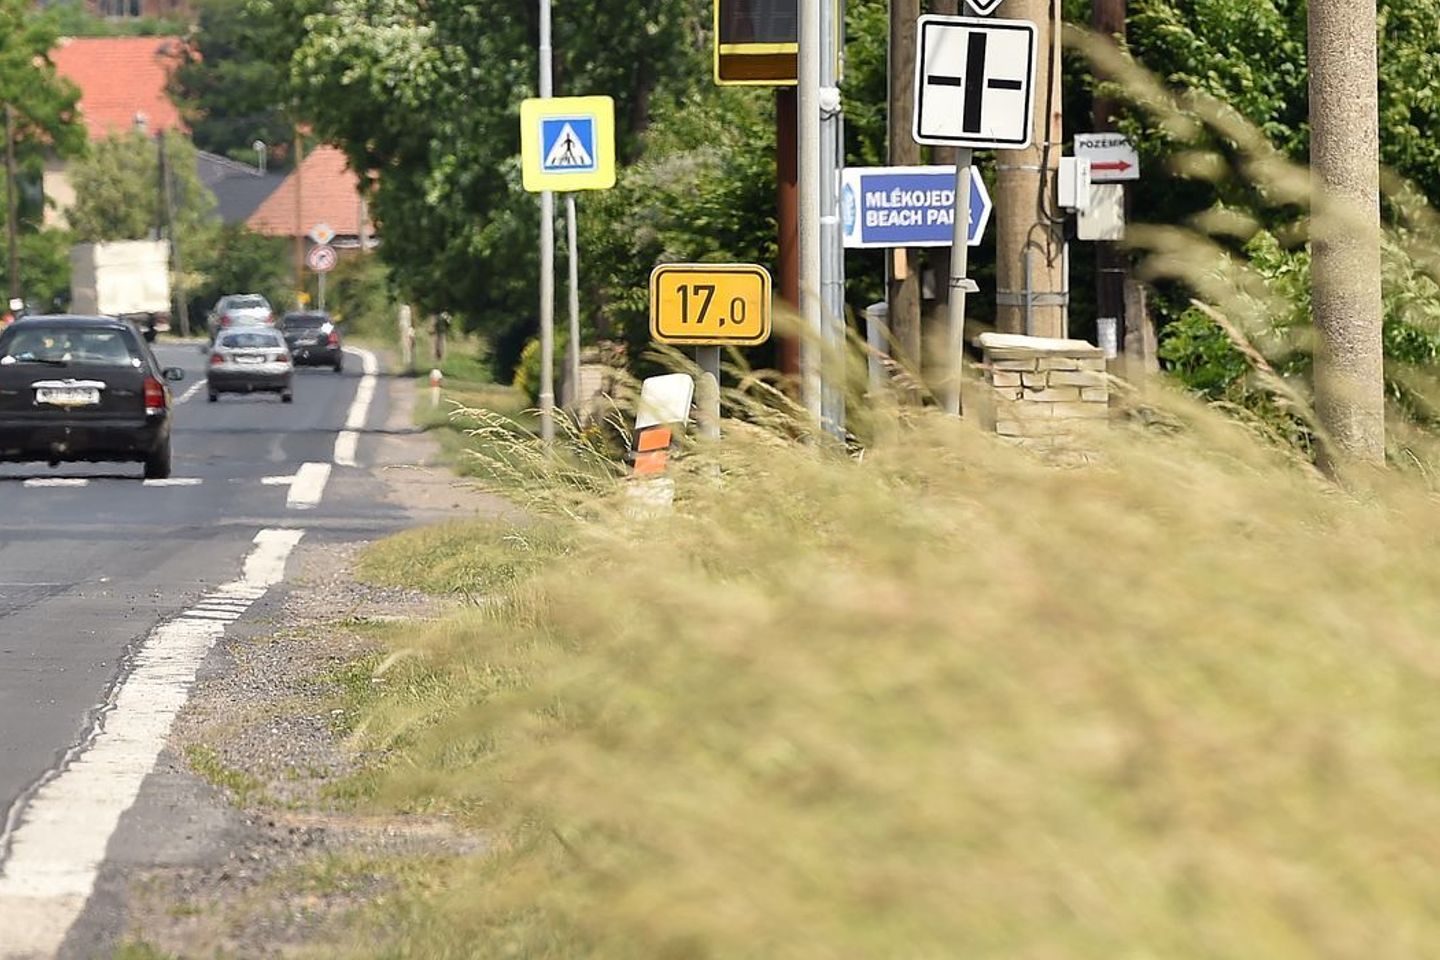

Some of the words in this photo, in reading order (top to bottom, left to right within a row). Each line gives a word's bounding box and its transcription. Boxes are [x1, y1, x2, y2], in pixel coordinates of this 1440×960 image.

[865, 187, 955, 208] MLÉKOJED
[866, 209, 922, 227] BEACH
[676, 284, 746, 327] 17,0
